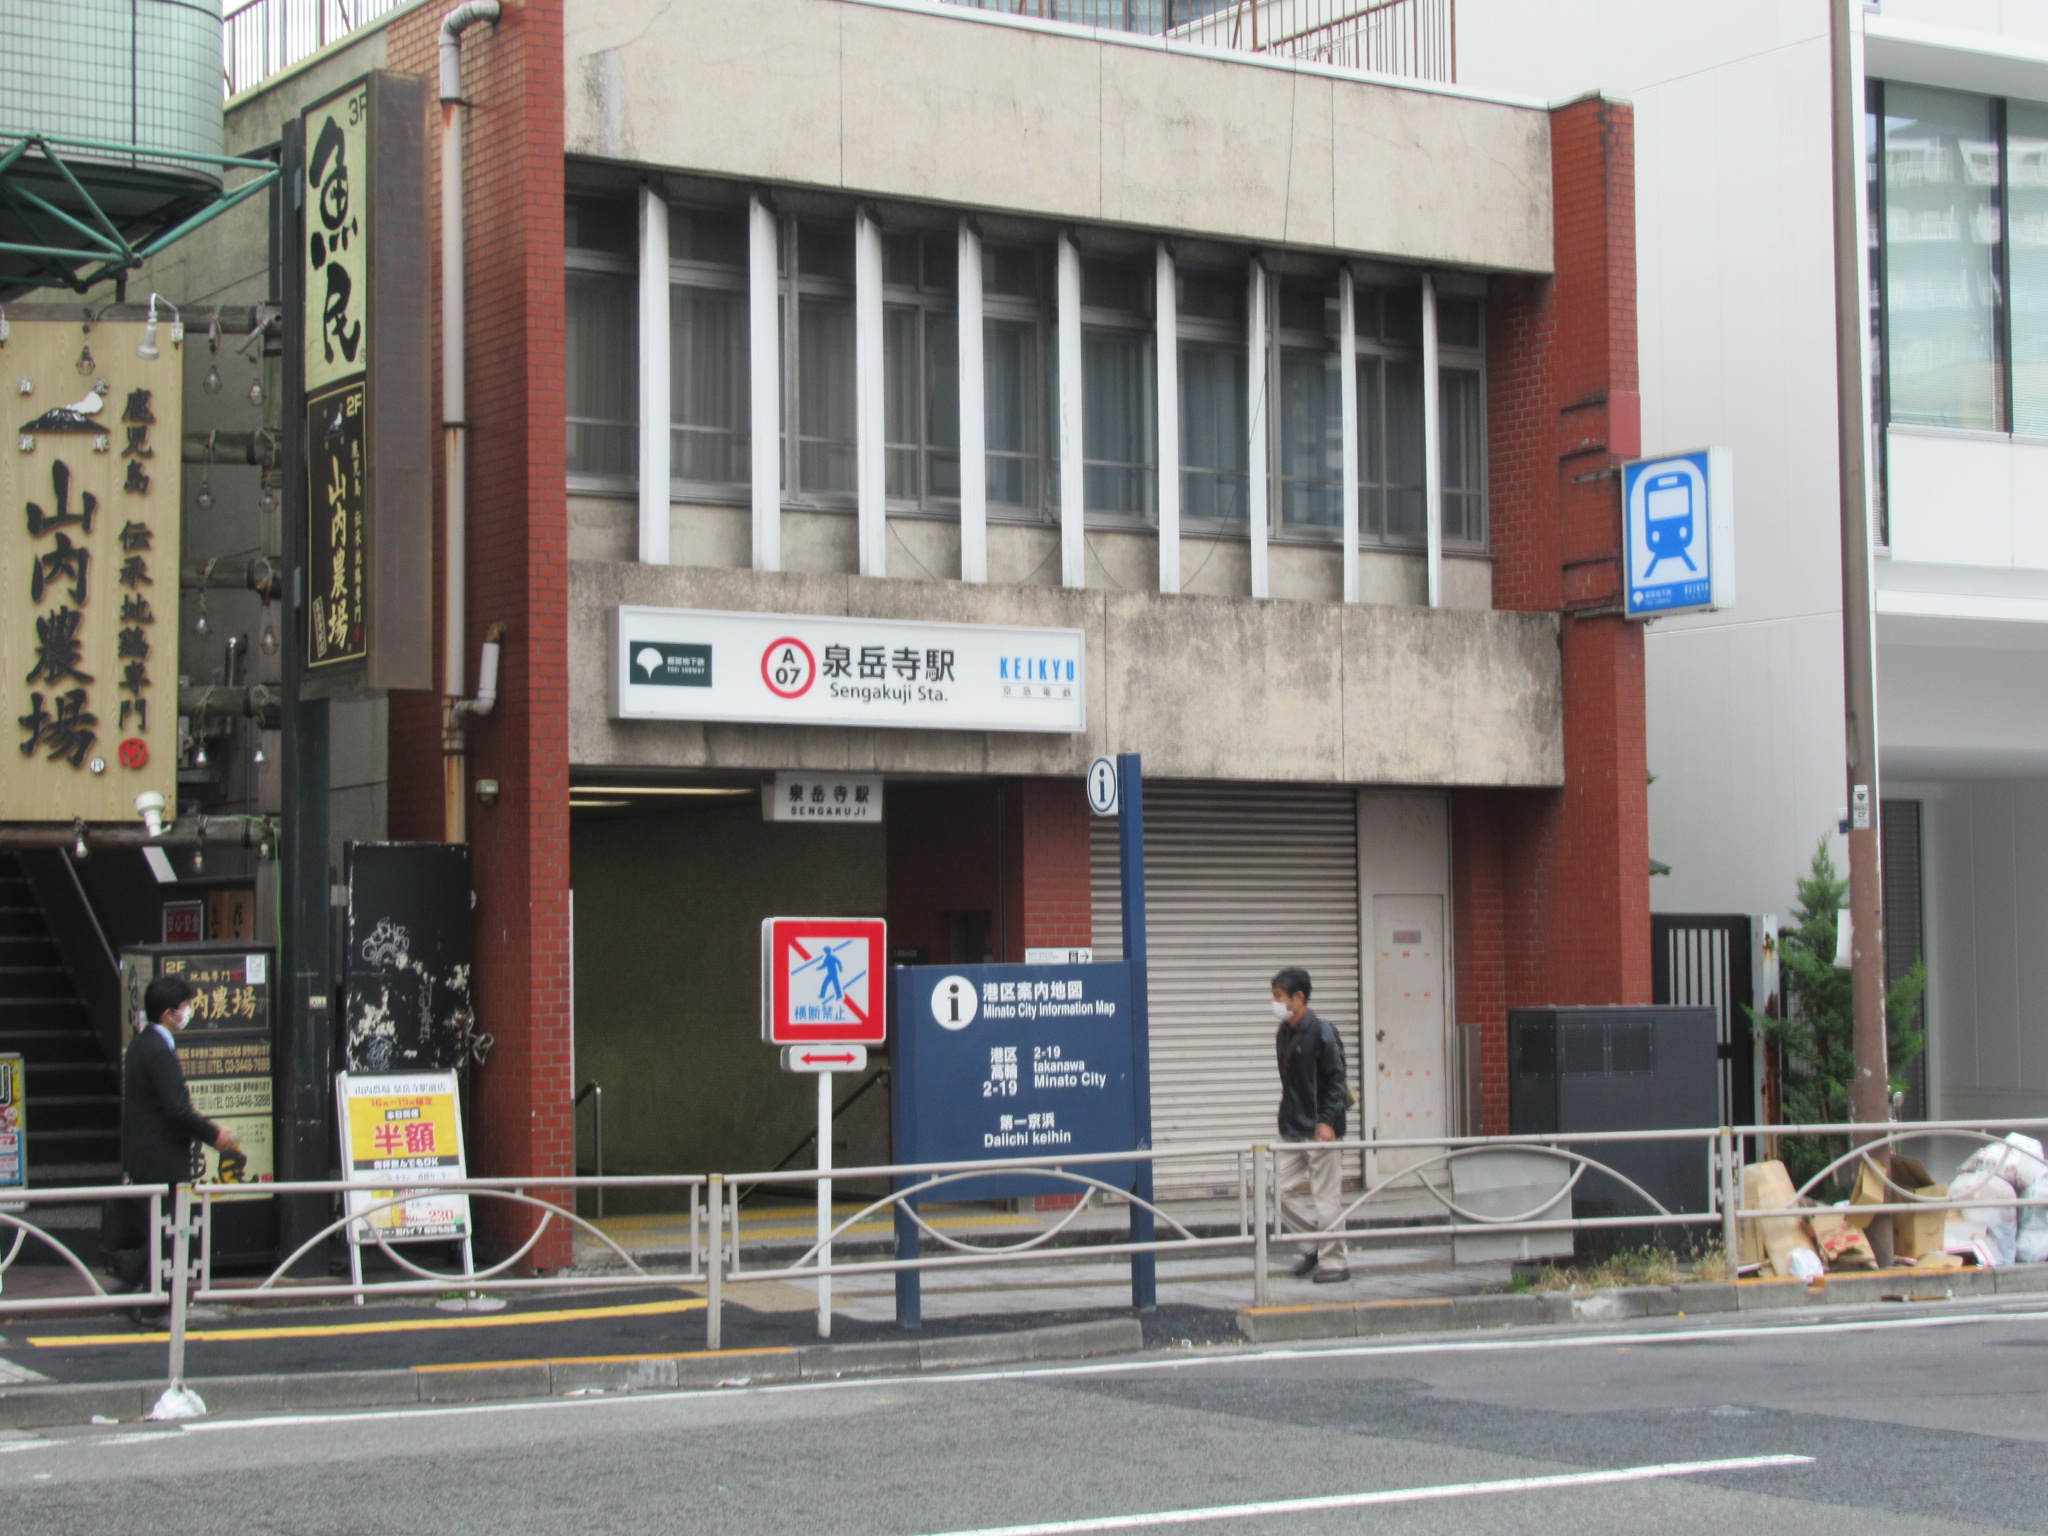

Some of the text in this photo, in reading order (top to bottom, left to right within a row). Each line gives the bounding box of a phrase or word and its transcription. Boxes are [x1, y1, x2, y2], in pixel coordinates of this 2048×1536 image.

[348, 92, 367, 126] 3F
[309, 116, 360, 364] 魚民
[346, 394, 363, 417] 2F
[118, 388, 155, 732] 鹿児島 伝承地鶏専門
[327, 455, 349, 650] 山内農場
[18, 459, 98, 769] 山内農場
[782, 648, 795, 664] A
[822, 643, 955, 683] 泉岳寺駅
[775, 667, 801, 685] 07
[1000, 657, 1075, 682] KEIKYU
[830, 682, 948, 704] Sengakuji Sta.
[789, 785, 870, 803] 泉岳寺駅
[791, 805, 867, 816] SENGAKUJI
[165, 961, 186, 975] 2F
[983, 981, 1083, 1002] 港区案内地図
[190, 985, 256, 1020] 内農場
[983, 1000, 1116, 1020] Minato City Information Map
[795, 1005, 847, 1021] 横断禁止
[991, 1047, 1018, 1063] 港区
[1033, 1046, 1061, 1059] 2-19
[991, 1064, 1018, 1080] 高輪
[1033, 1060, 1085, 1073] takanawa
[983, 1080, 1018, 1097] 2-19
[1034, 1073, 1107, 1089] Minato City
[1000, 1112, 1055, 1131] 第一京浜
[375, 1122, 436, 1155] 半額
[984, 1130, 1071, 1148] Daiichi keihin
[429, 1209, 454, 1223] 230
